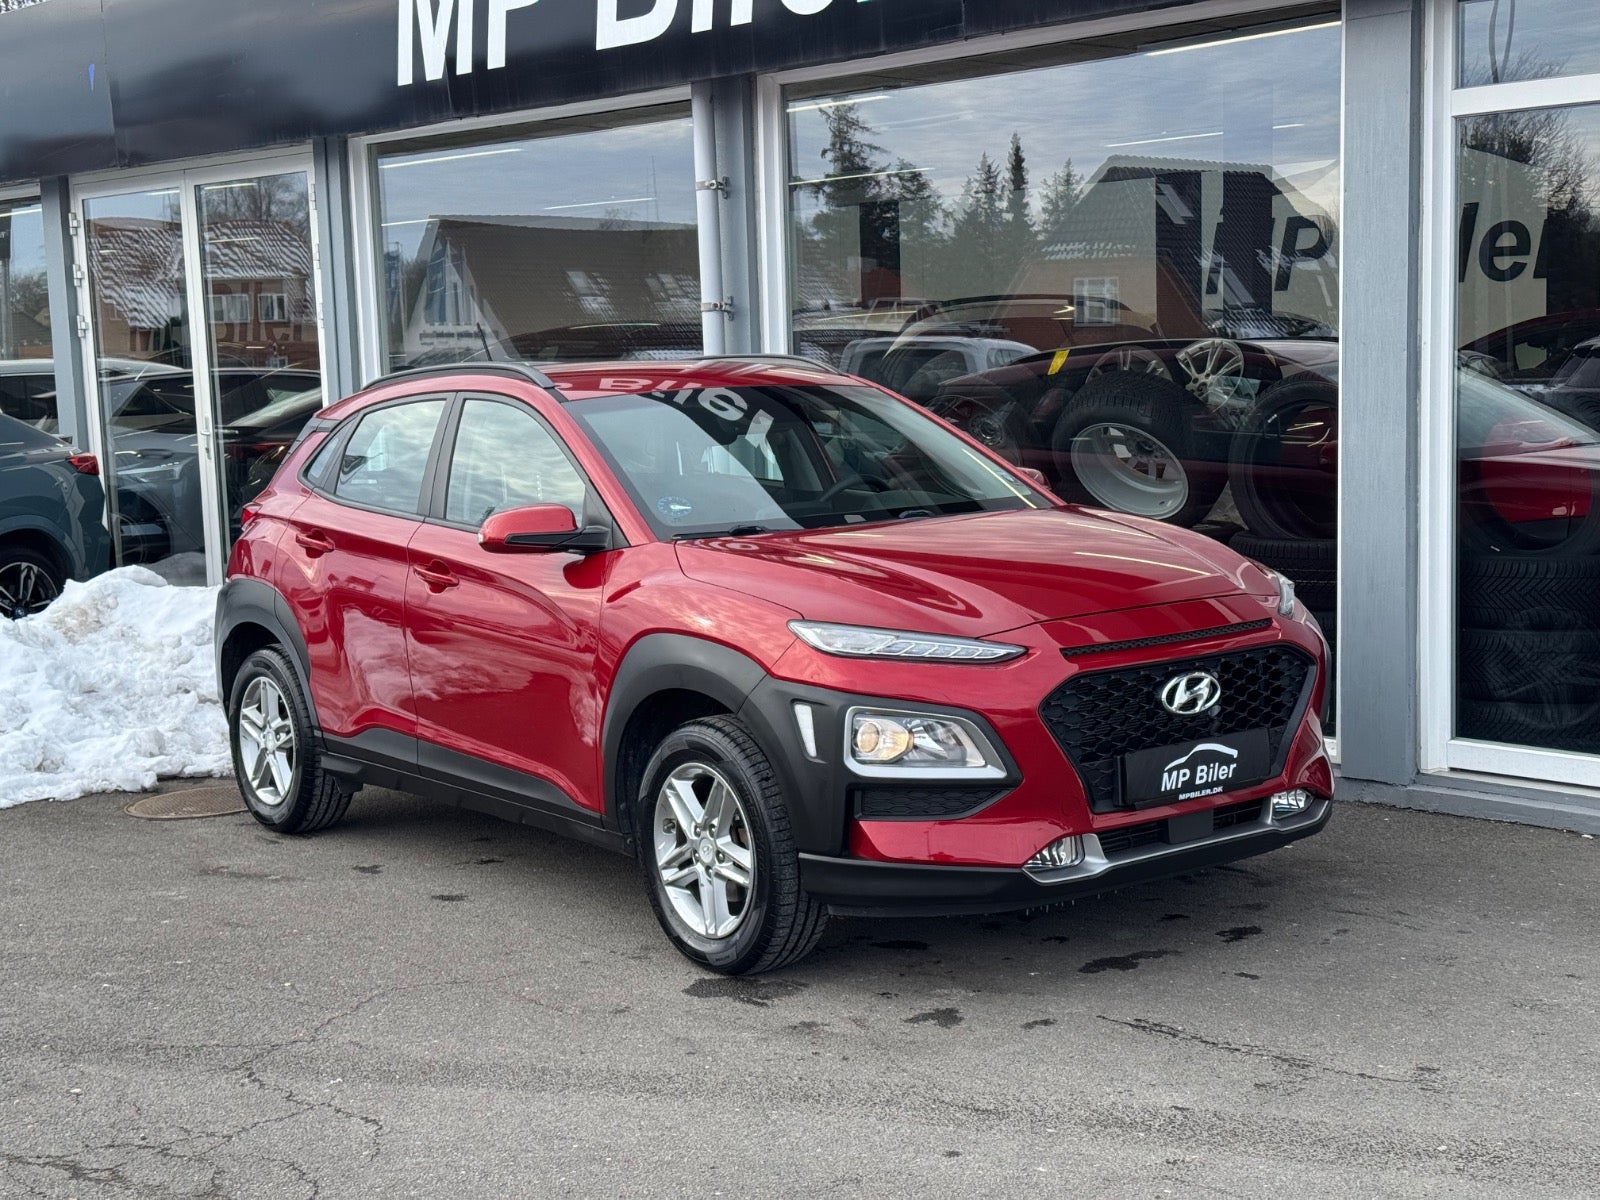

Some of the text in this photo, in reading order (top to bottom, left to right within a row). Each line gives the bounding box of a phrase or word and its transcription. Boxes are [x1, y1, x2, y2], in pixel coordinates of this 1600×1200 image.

[1161, 762, 1237, 792] MP Biler
[1179, 786, 1223, 800] MPBILER.DK
